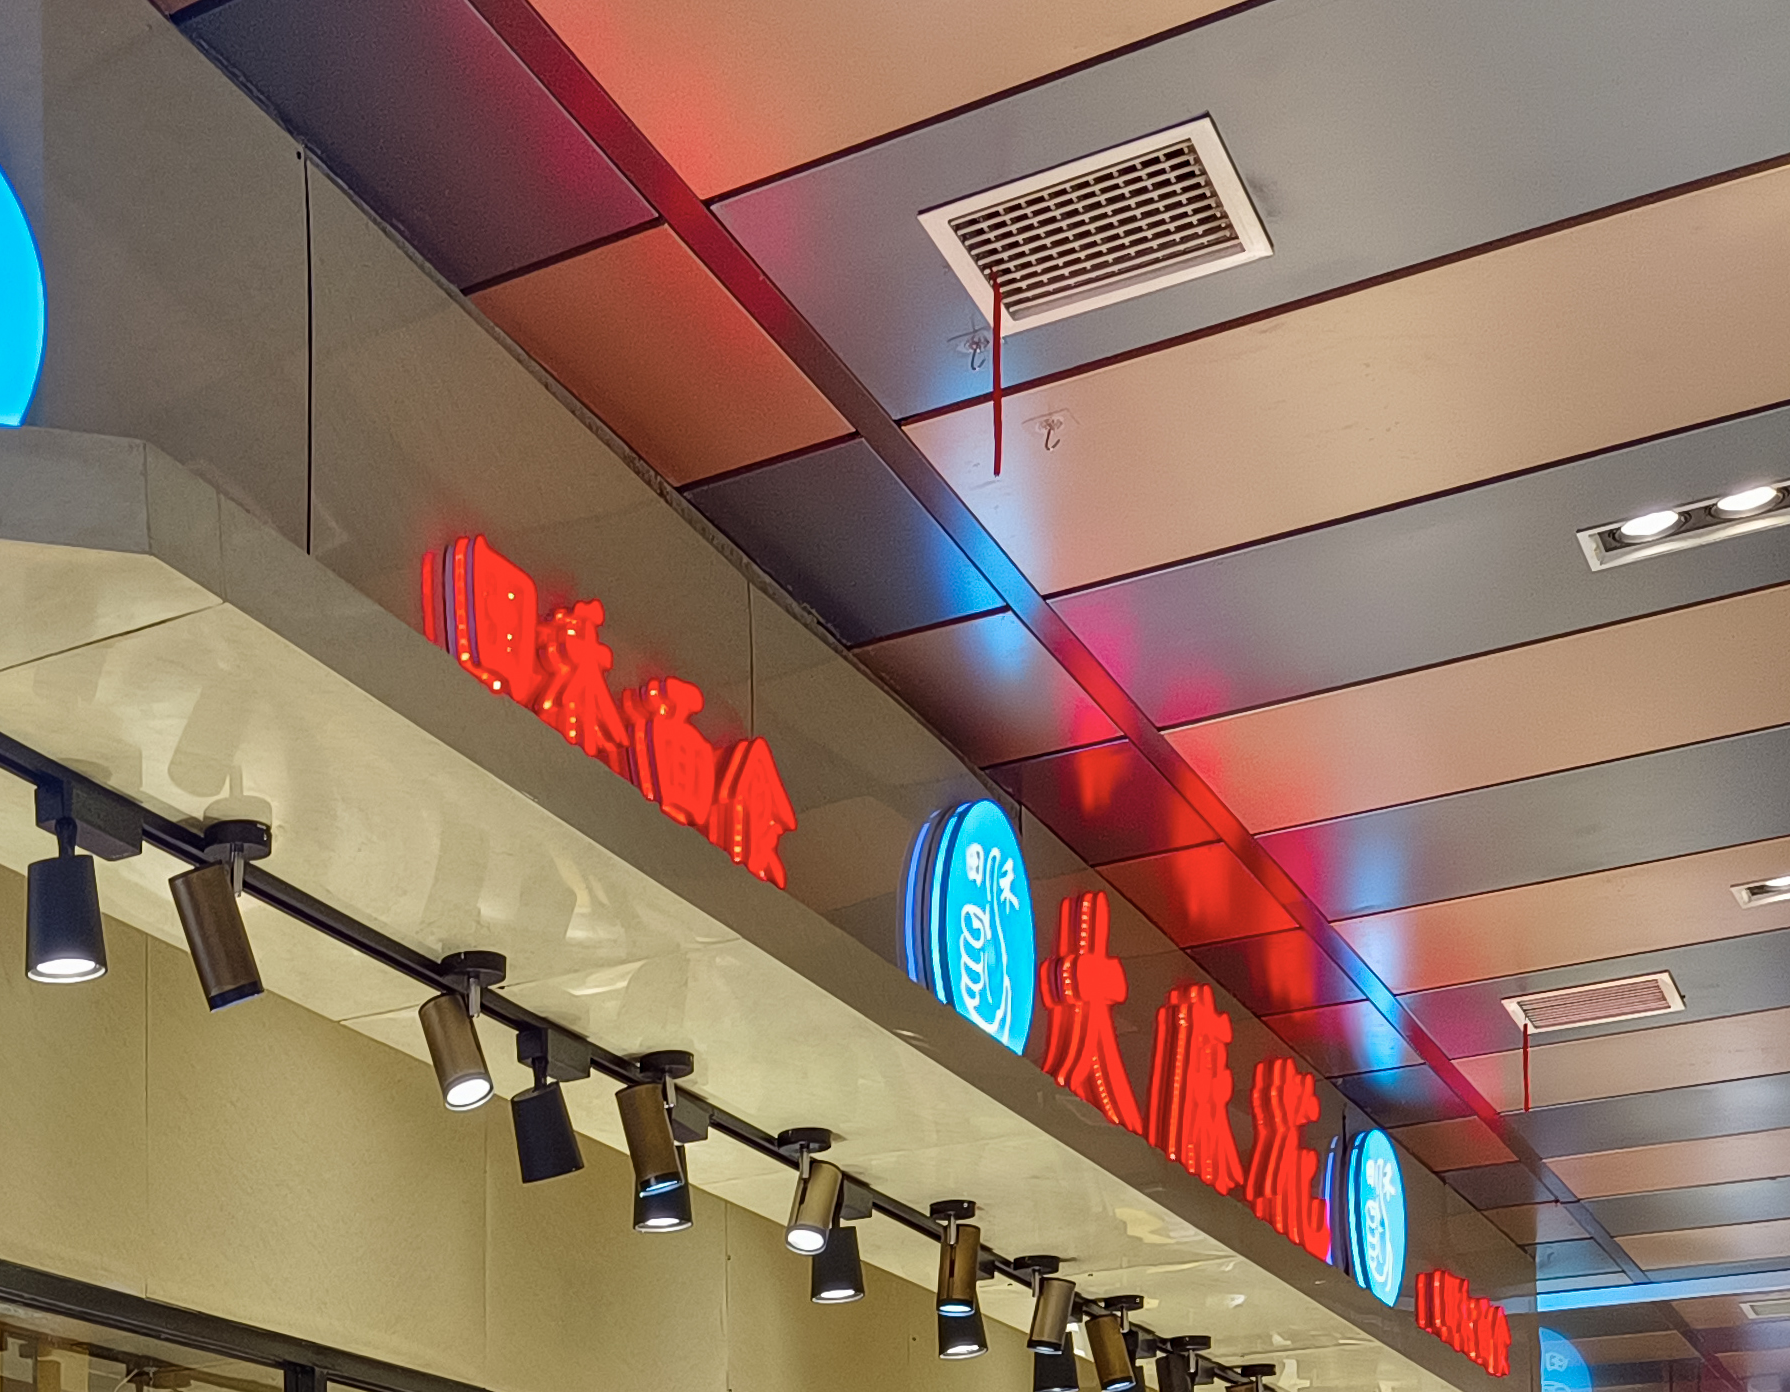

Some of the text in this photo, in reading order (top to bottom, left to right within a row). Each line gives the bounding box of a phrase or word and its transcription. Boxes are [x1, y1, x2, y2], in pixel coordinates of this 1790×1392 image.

[965, 842, 1020, 914] 田禾
[1040, 891, 1331, 1263] 大麻花
